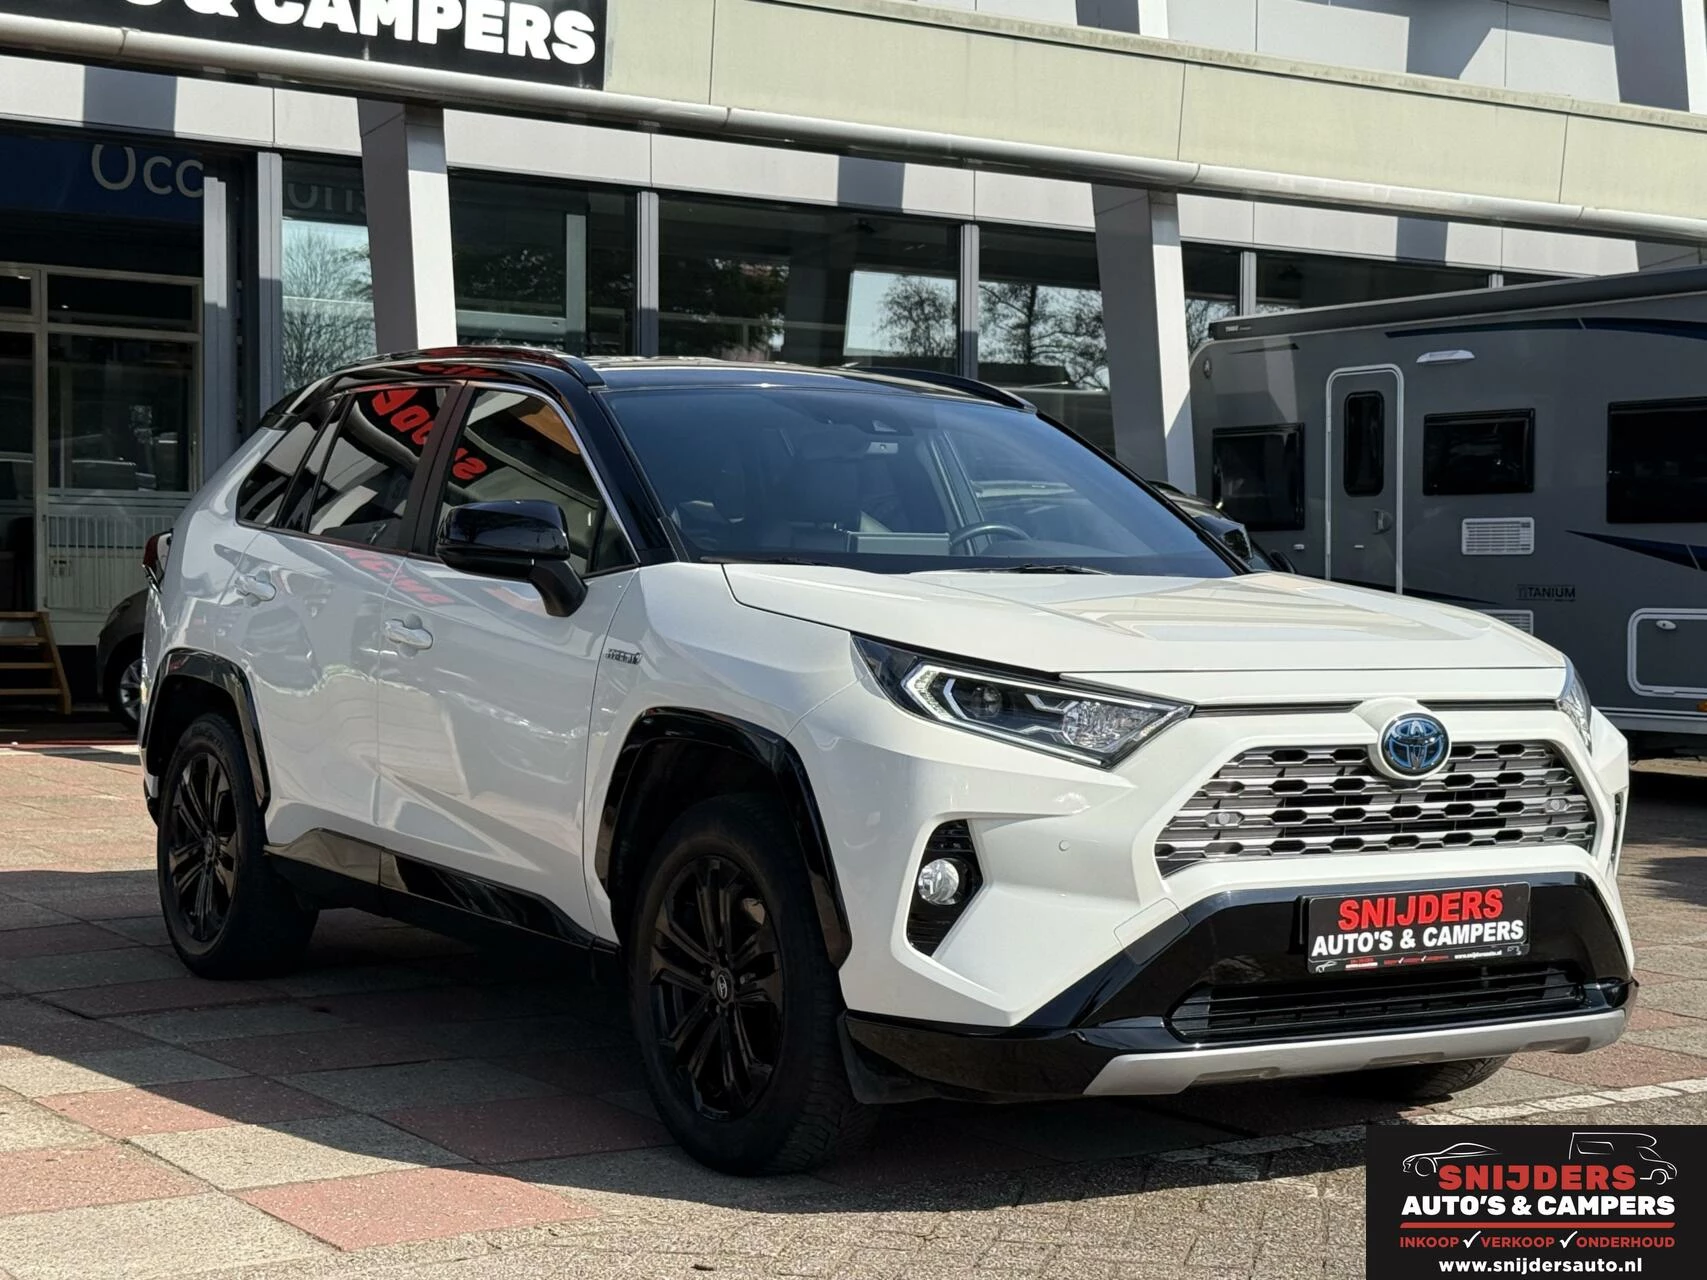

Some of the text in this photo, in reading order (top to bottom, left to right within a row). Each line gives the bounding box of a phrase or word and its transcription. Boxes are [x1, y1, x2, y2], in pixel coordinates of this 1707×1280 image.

[1338, 889, 1504, 931] SNIJDERS
[1311, 920, 1524, 957] AUTO'S & CAMPERS
